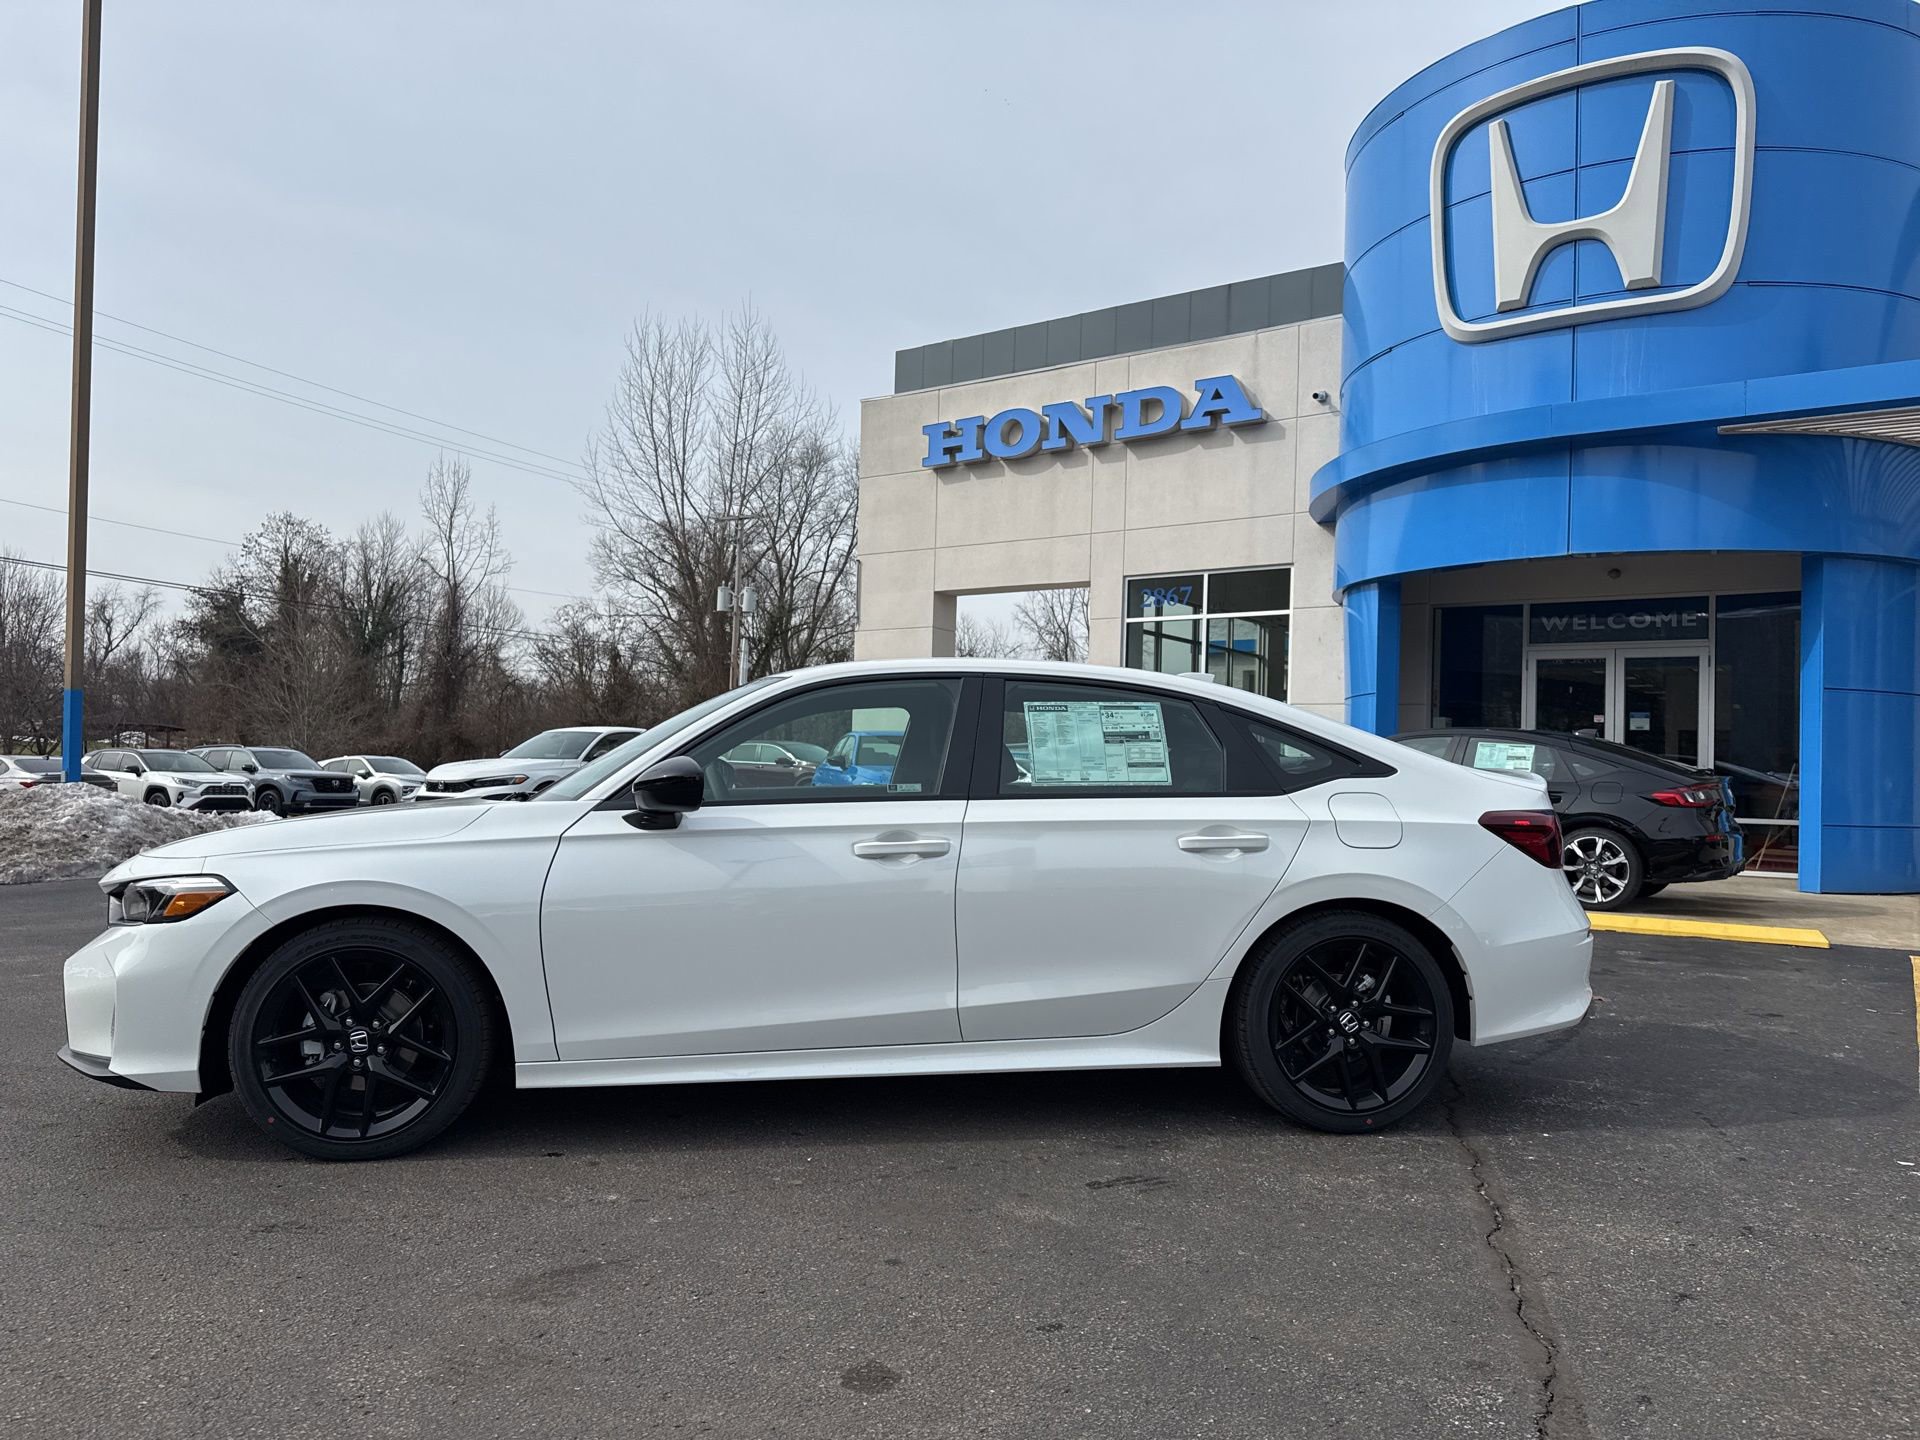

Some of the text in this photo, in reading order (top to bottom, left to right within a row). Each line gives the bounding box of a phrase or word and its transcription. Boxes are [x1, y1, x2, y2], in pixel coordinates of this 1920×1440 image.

[922, 374, 1265, 468] HONDA
[1140, 585, 1193, 609] 2867
[1541, 610, 1697, 632] WELCOME
